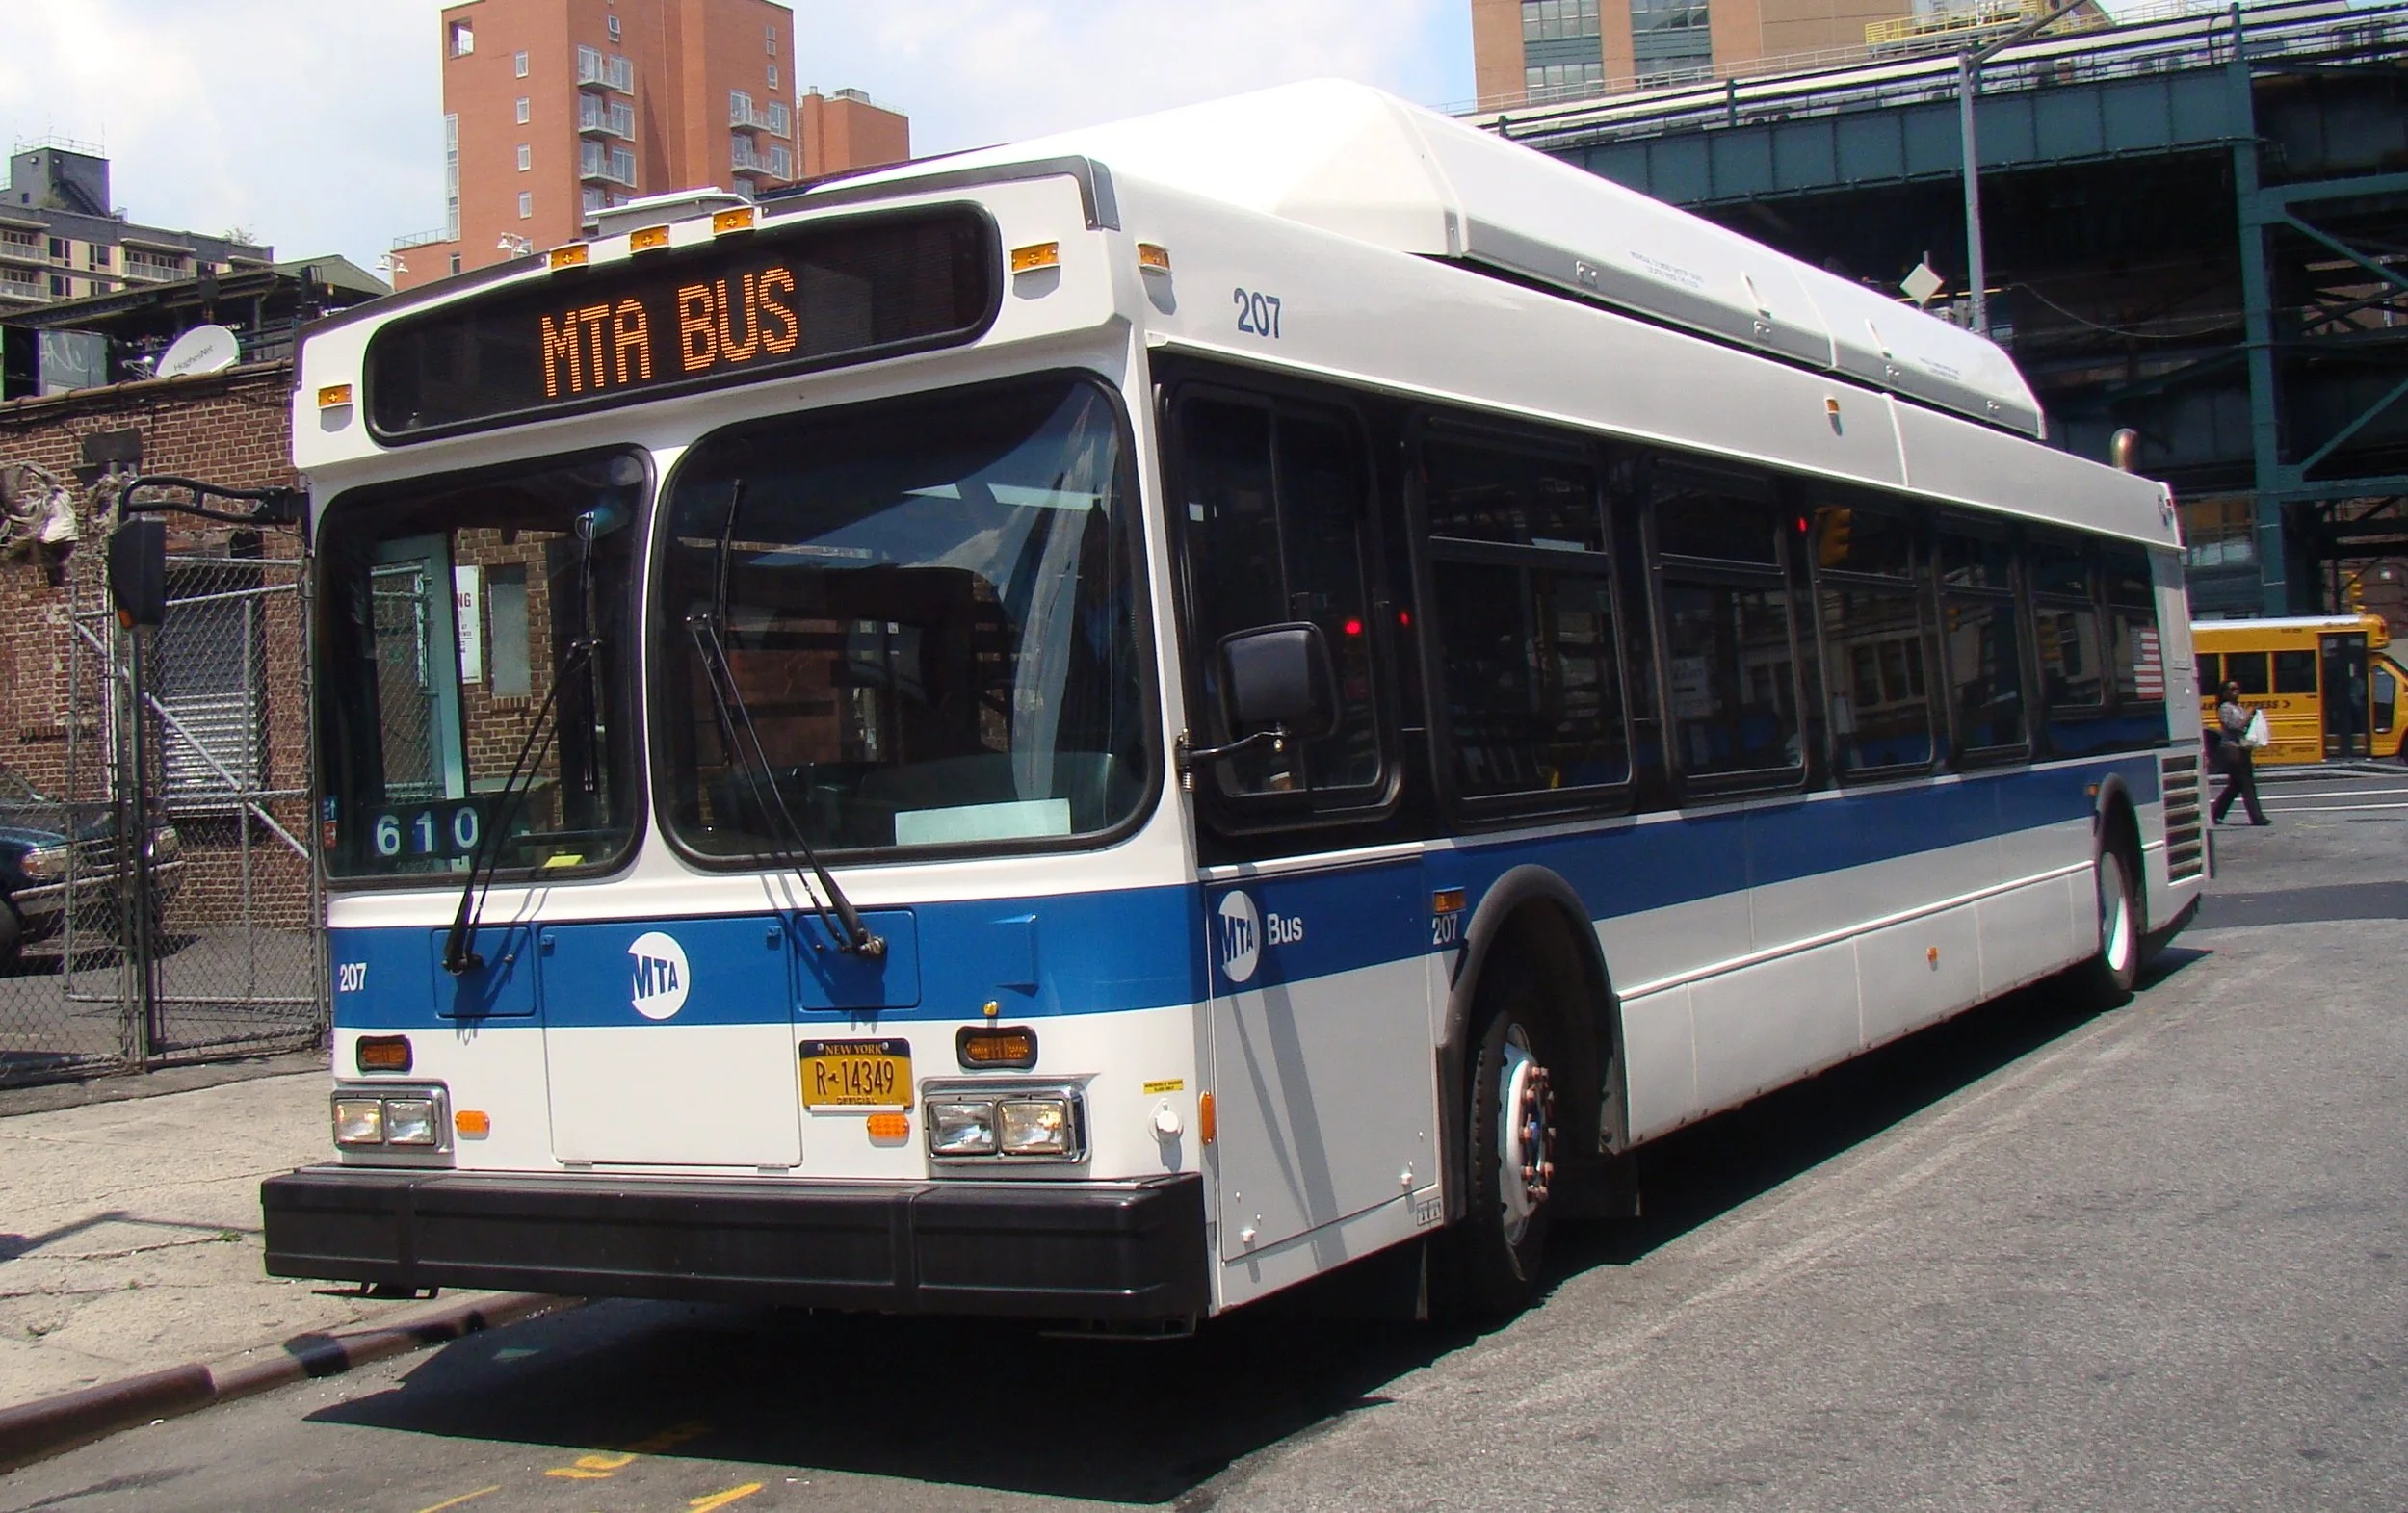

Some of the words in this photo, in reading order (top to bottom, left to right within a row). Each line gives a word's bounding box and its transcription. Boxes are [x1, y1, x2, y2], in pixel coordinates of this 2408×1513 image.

[541, 299, 652, 397] MTA
[678, 266, 798, 372] BUS
[1233, 287, 1281, 339] 207
[376, 806, 480, 856] 610
[1220, 913, 1254, 965] MTA
[1267, 913, 1303, 946] Bus
[1432, 914, 1457, 945] 207
[340, 962, 367, 992] 207
[631, 952, 679, 1001] MTA
[825, 1044, 853, 1056] NEW
[853, 1043, 883, 1056] YORK
